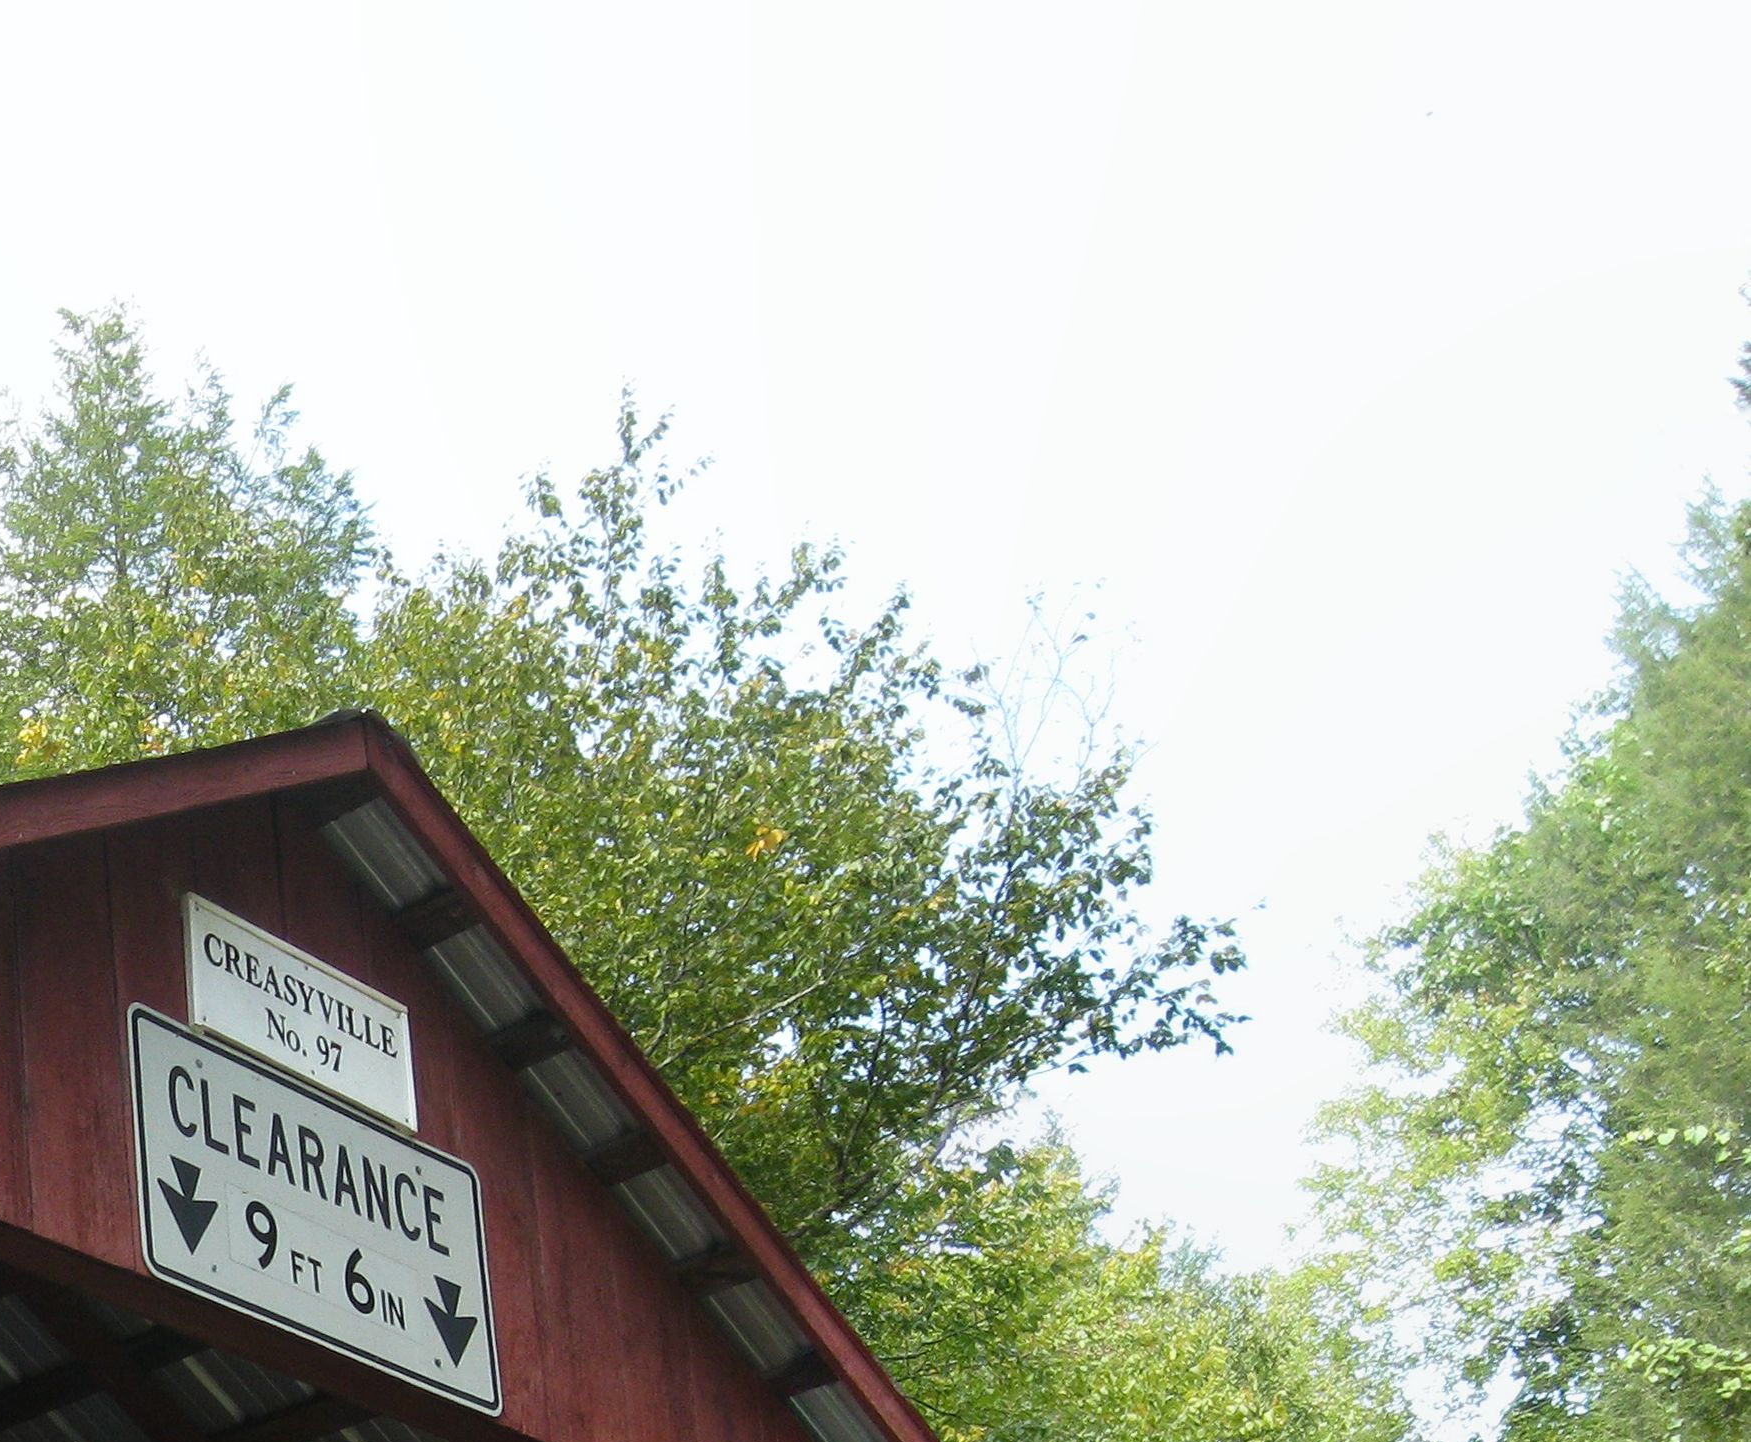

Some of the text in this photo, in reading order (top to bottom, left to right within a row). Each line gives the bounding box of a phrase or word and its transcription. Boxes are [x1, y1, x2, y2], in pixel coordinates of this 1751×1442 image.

[203, 932, 399, 1059] CREASYVILLE
[265, 1007, 343, 1073] No. 97
[168, 1065, 451, 1257] CLEARANCE
[245, 1200, 406, 1332] 9 FT 6 IN
